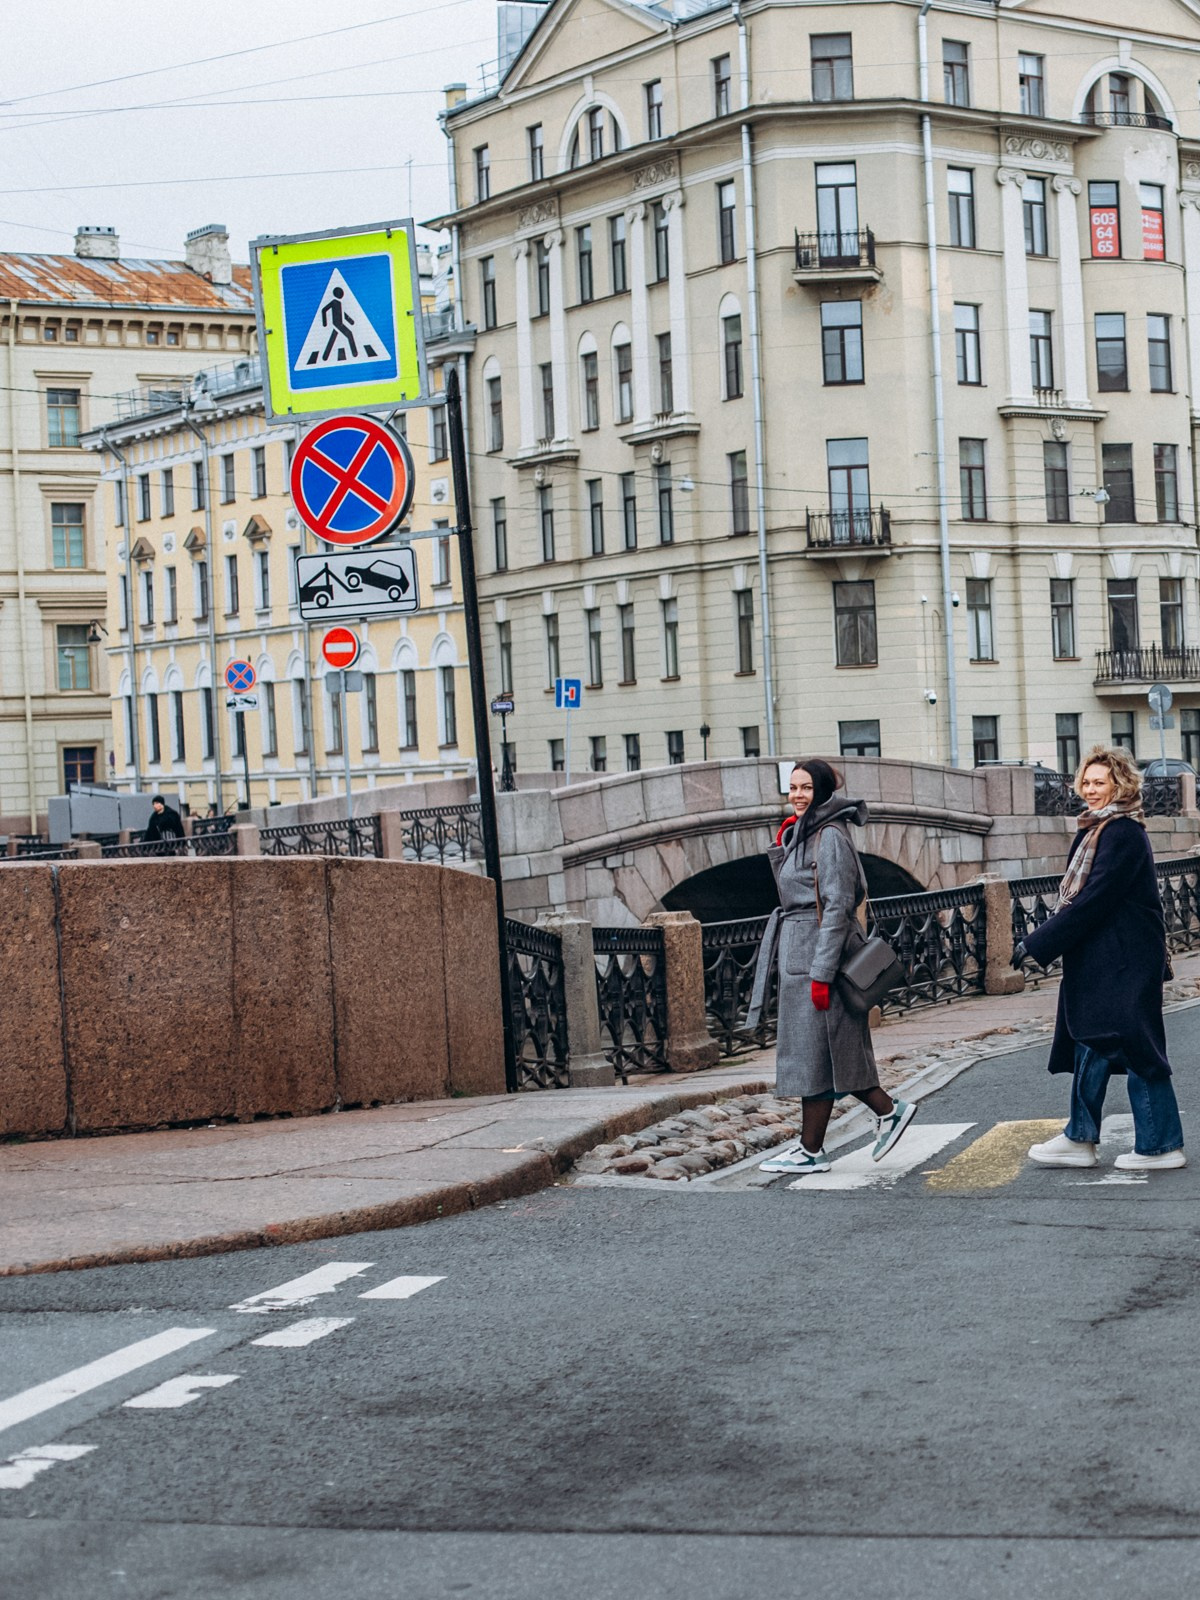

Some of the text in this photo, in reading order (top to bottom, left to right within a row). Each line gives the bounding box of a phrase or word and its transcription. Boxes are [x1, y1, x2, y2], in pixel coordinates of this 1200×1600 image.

[1092, 213, 1116, 225] 603
[1096, 226, 1113, 239] 64
[1097, 240, 1114, 253] 65
